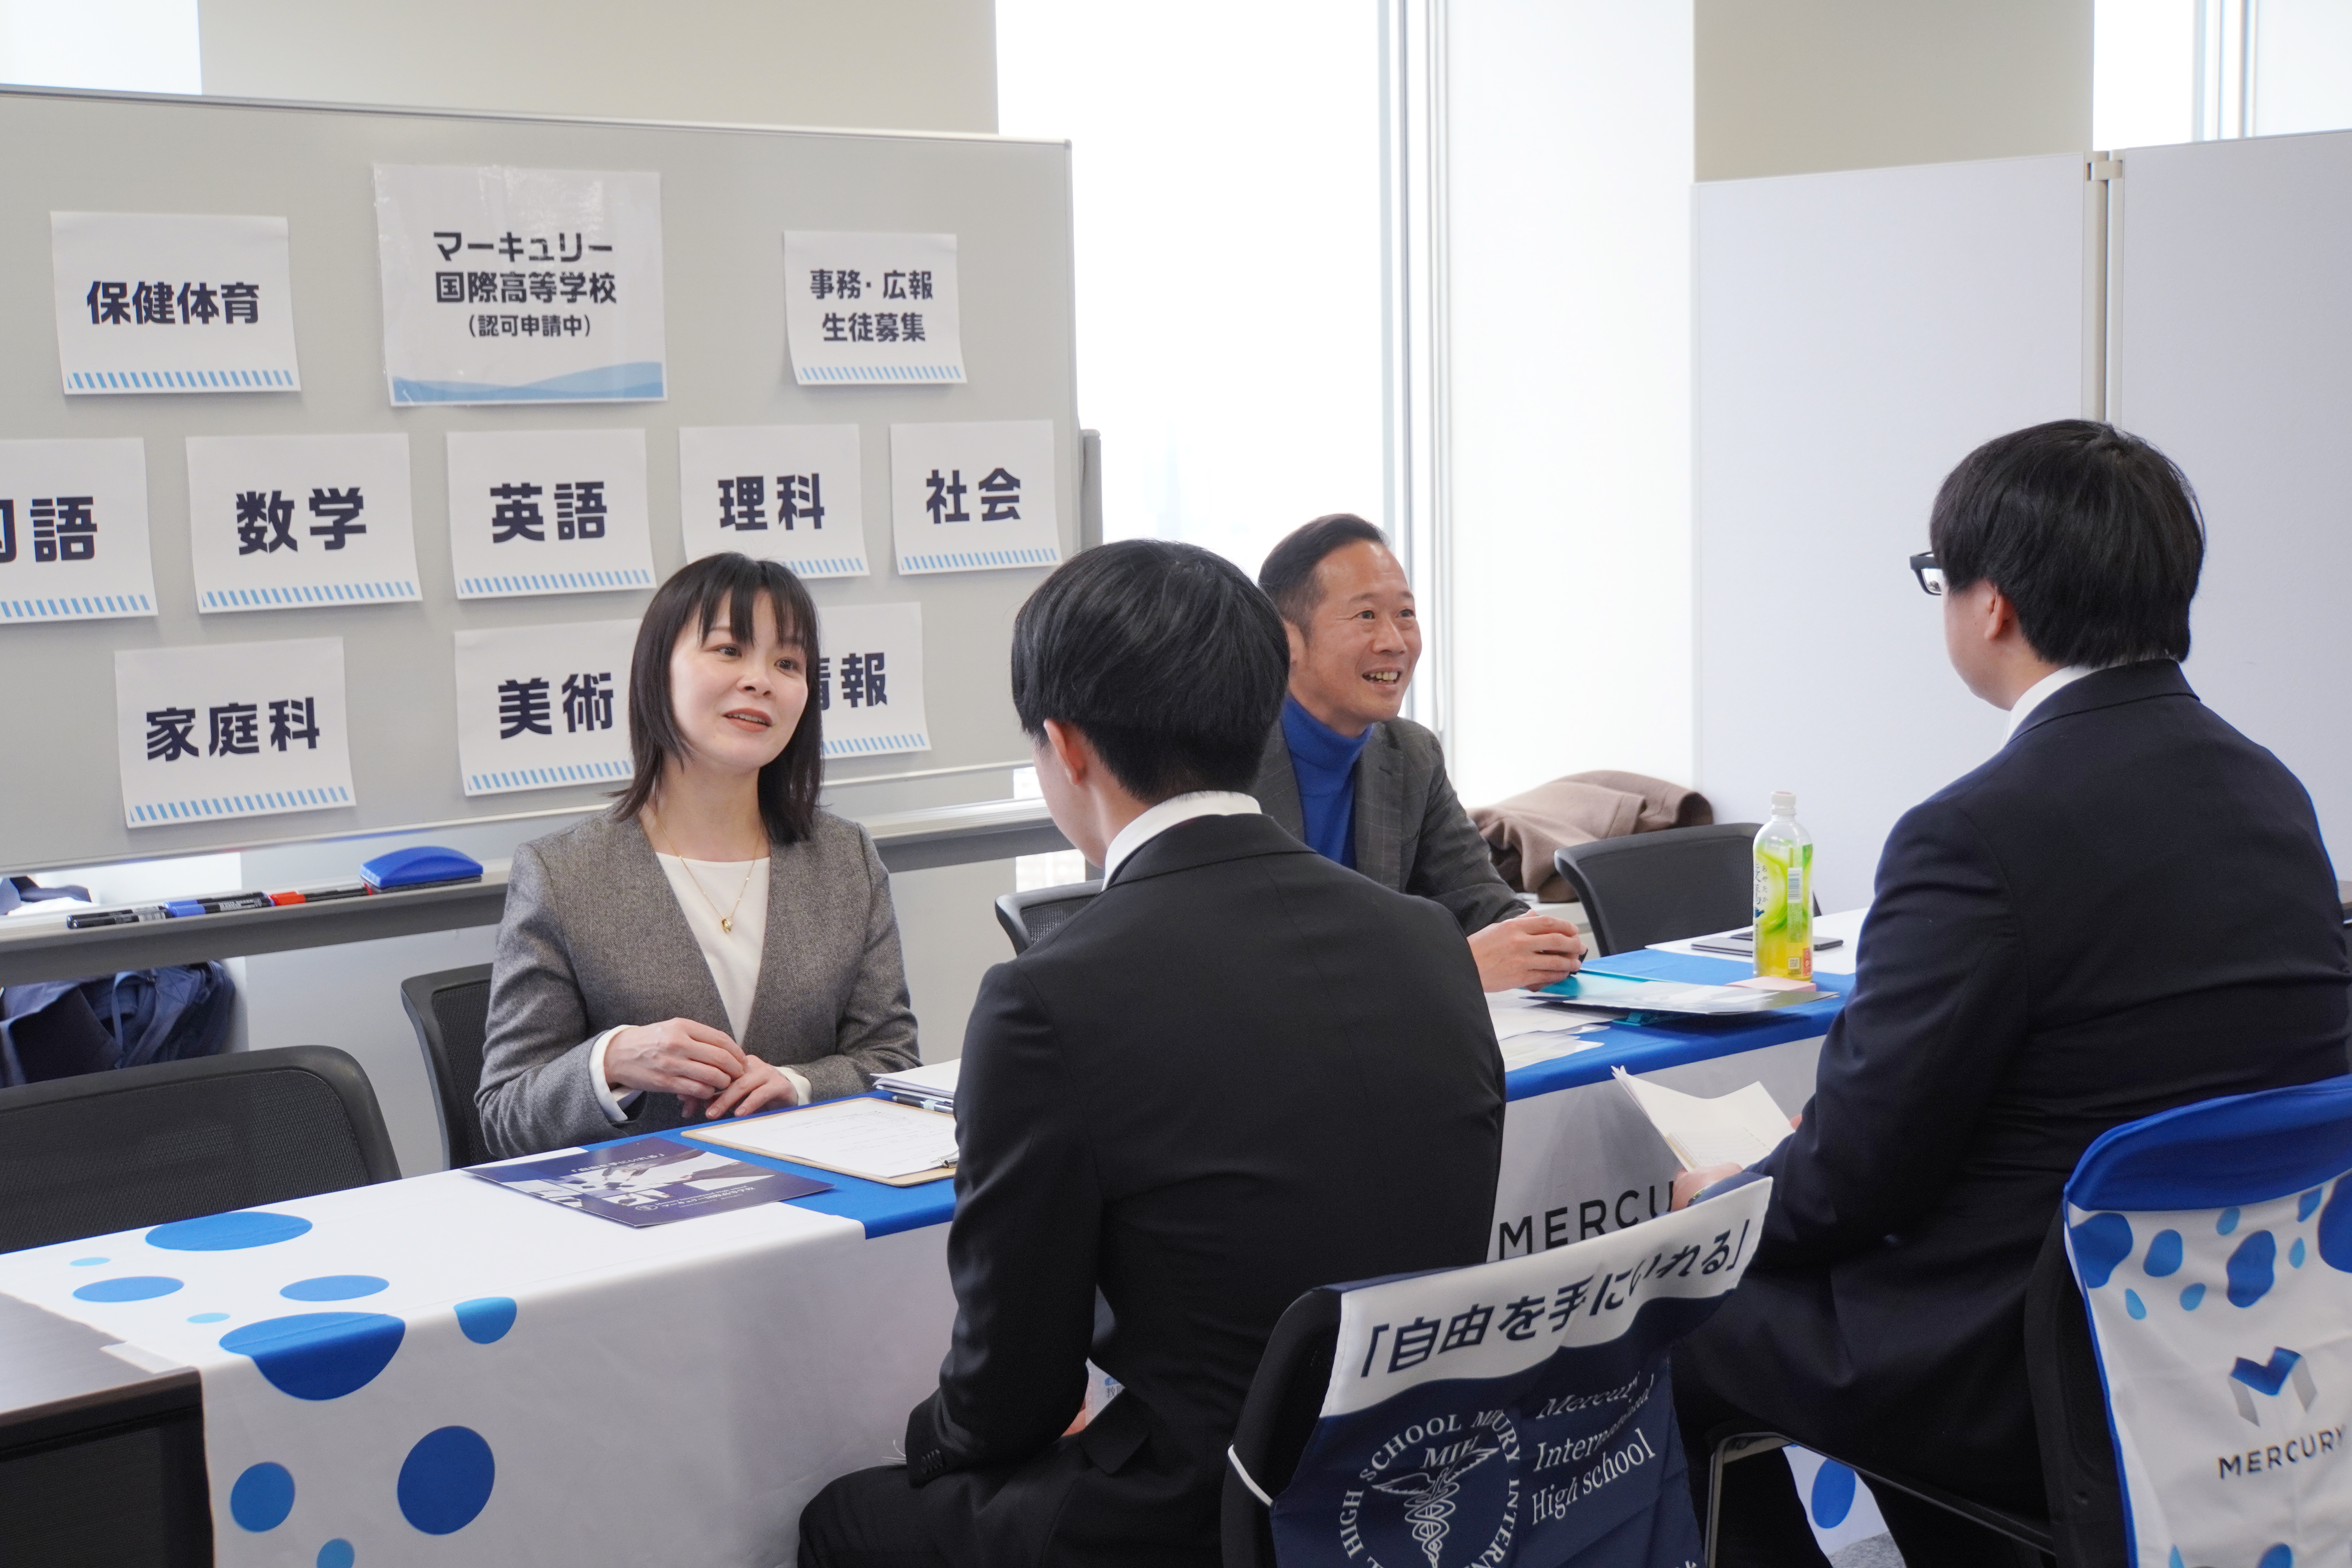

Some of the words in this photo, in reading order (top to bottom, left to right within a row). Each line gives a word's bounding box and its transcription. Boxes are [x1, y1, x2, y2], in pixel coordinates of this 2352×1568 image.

[434, 232, 612, 262] マーキュリー
[87, 281, 259, 325] 保健体育
[436, 271, 617, 303] 国際高等学校
[810, 269, 933, 299] 事務・広報
[469, 314, 590, 337] (認可申請中)
[822, 312, 926, 342] 生徒募集
[236, 487, 367, 555] 数学
[490, 481, 607, 543] 英語
[718, 473, 825, 531] 理科
[926, 468, 1021, 524] 社会
[146, 697, 320, 762] 家庭科
[498, 673, 614, 739] 美術
[1361, 1219, 1750, 1377] 「自由を手にいれる」
[1533, 1373, 1654, 1472] Internl
[1340, 1489, 1364, 1560] HIGH
[1359, 1414, 1461, 1481] SCHOOL
[1470, 1409, 1521, 1463] MURY
[1532, 1484, 1578, 1526] High
[1583, 1427, 1656, 1495] school
